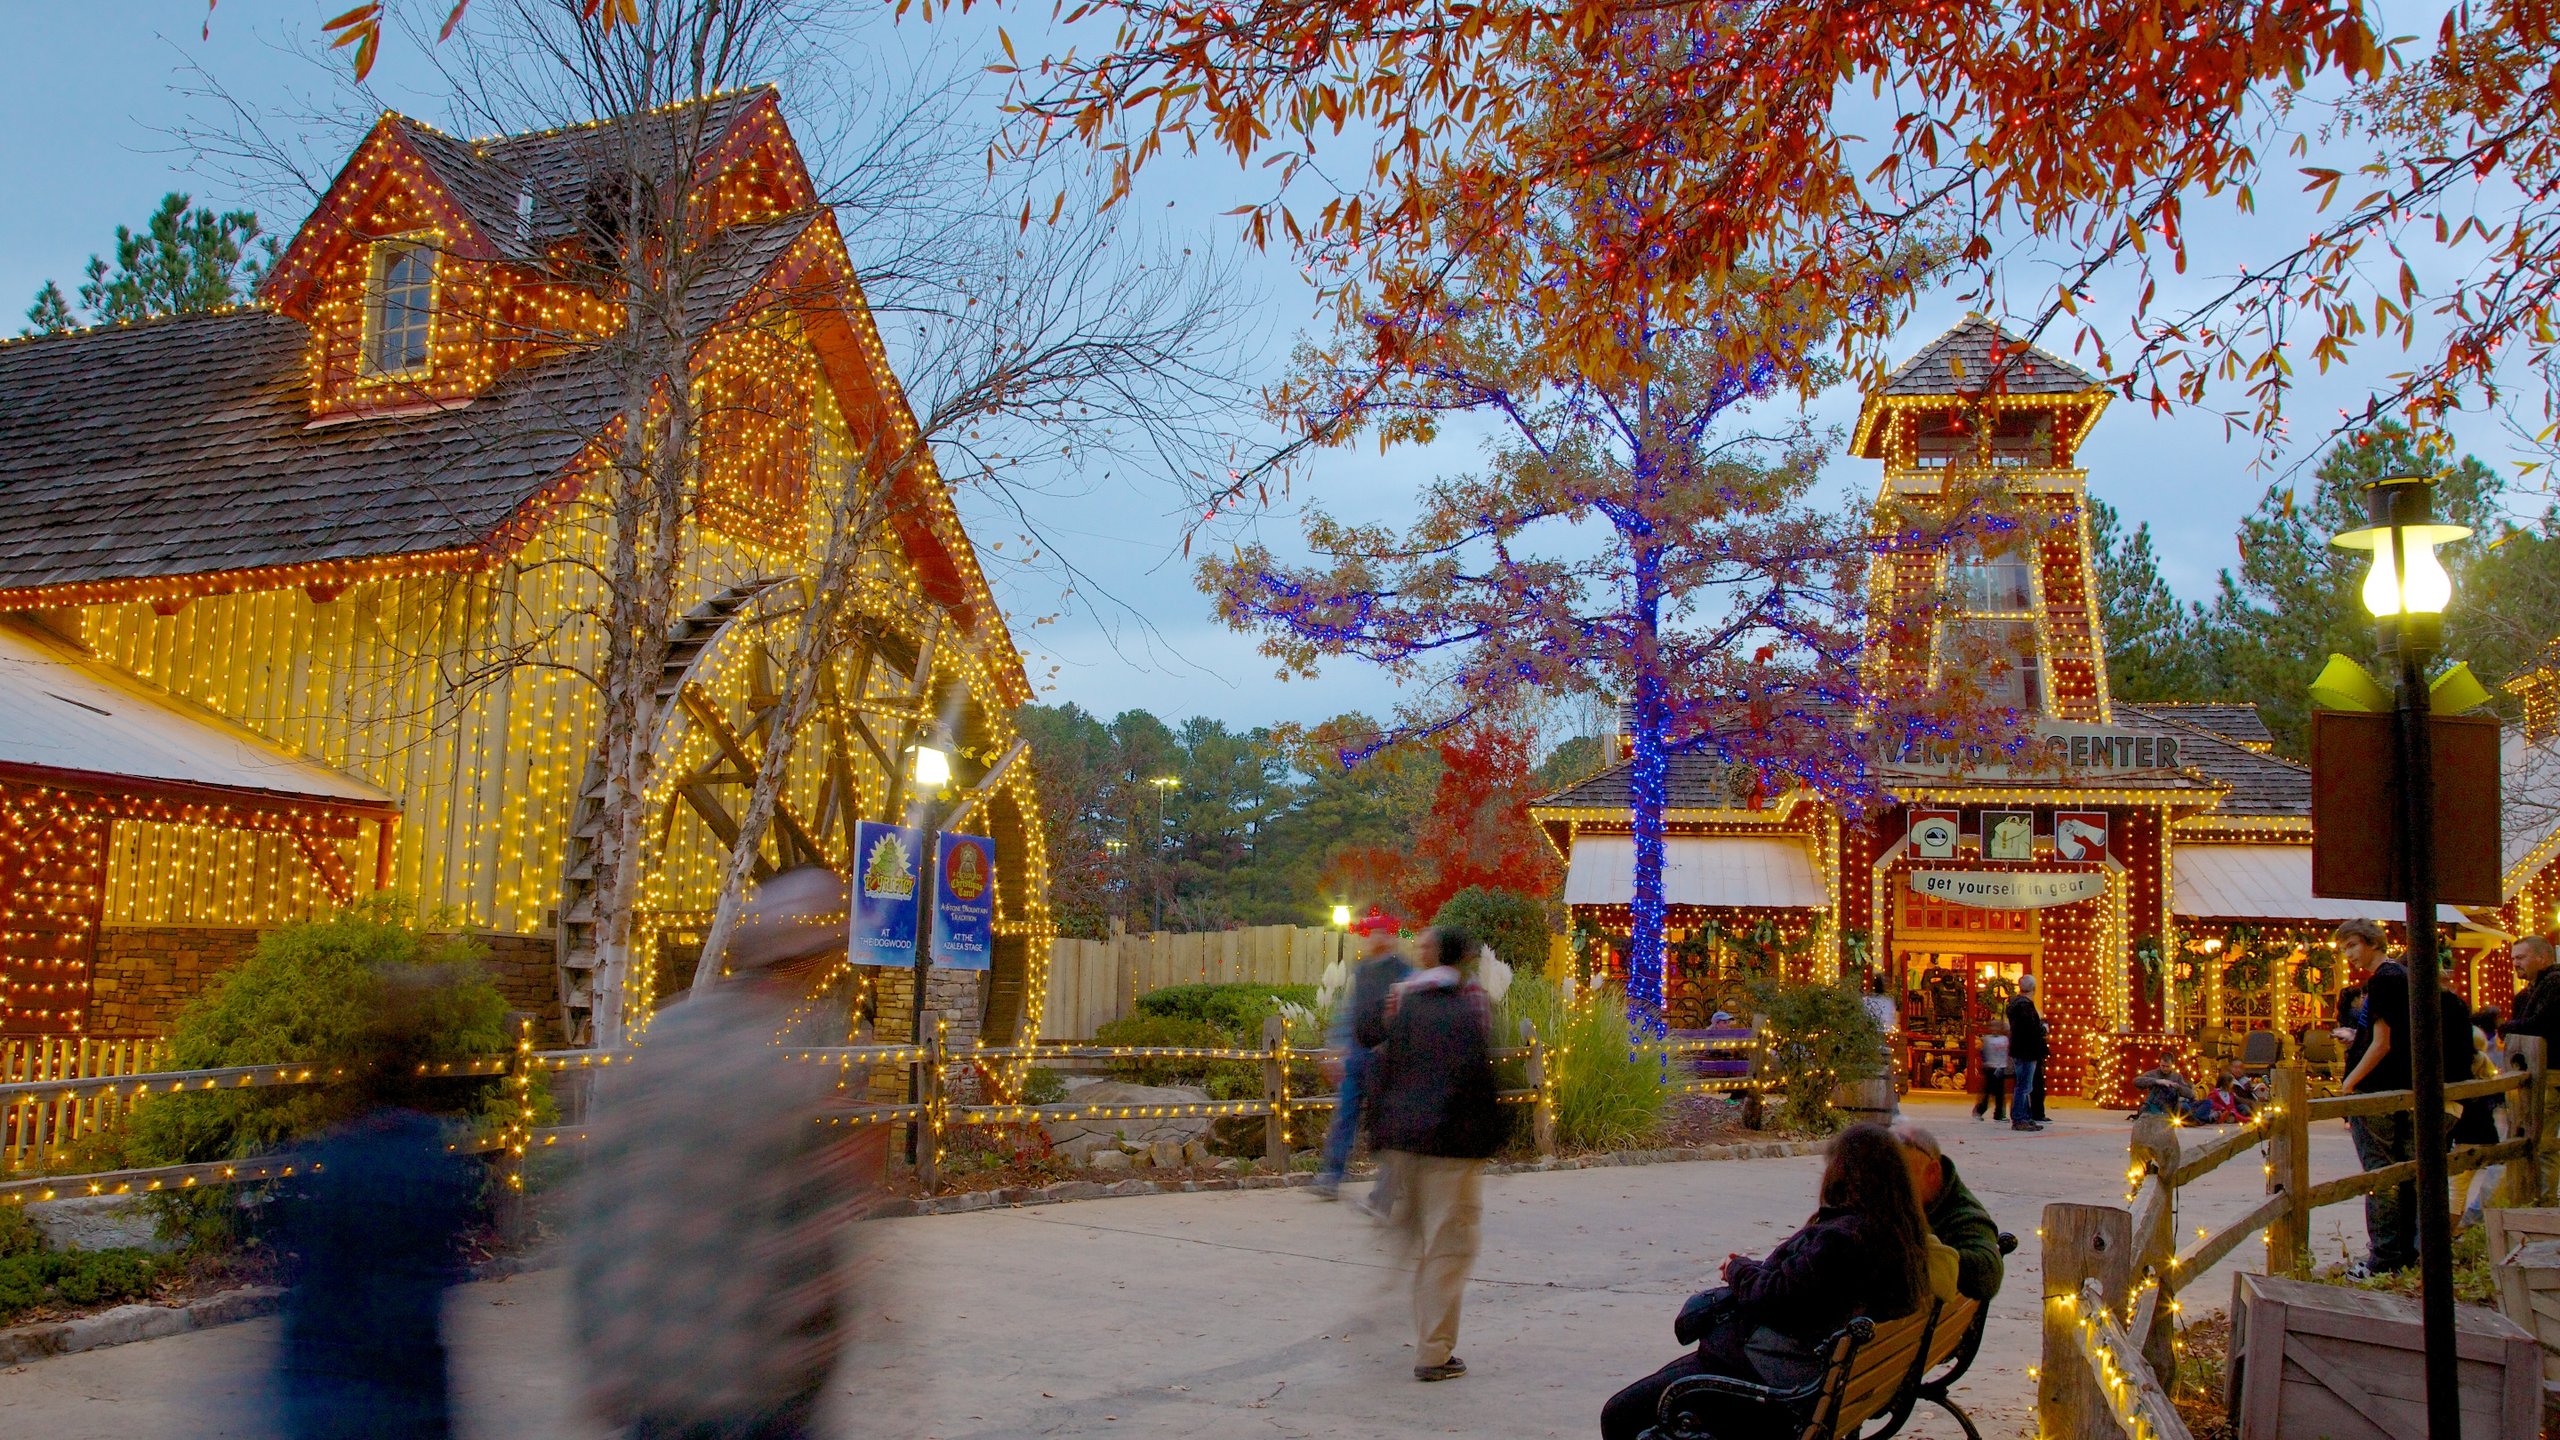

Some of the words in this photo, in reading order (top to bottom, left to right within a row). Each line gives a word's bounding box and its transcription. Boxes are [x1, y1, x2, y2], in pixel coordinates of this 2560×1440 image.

[2045, 735, 2179, 767] CENTER
[1927, 877, 1952, 891] get
[1958, 882, 2024, 896] yourself
[2028, 883, 2042, 895] in
[2050, 879, 2084, 897] gear
[881, 928, 890, 937] AT
[953, 933, 962, 941] AT
[962, 933, 973, 942] THE
[860, 937, 872, 947] THE
[874, 938, 912, 949] DOGWOOD
[944, 941, 963, 951] AZALEA
[964, 943, 983, 952] STAGE
